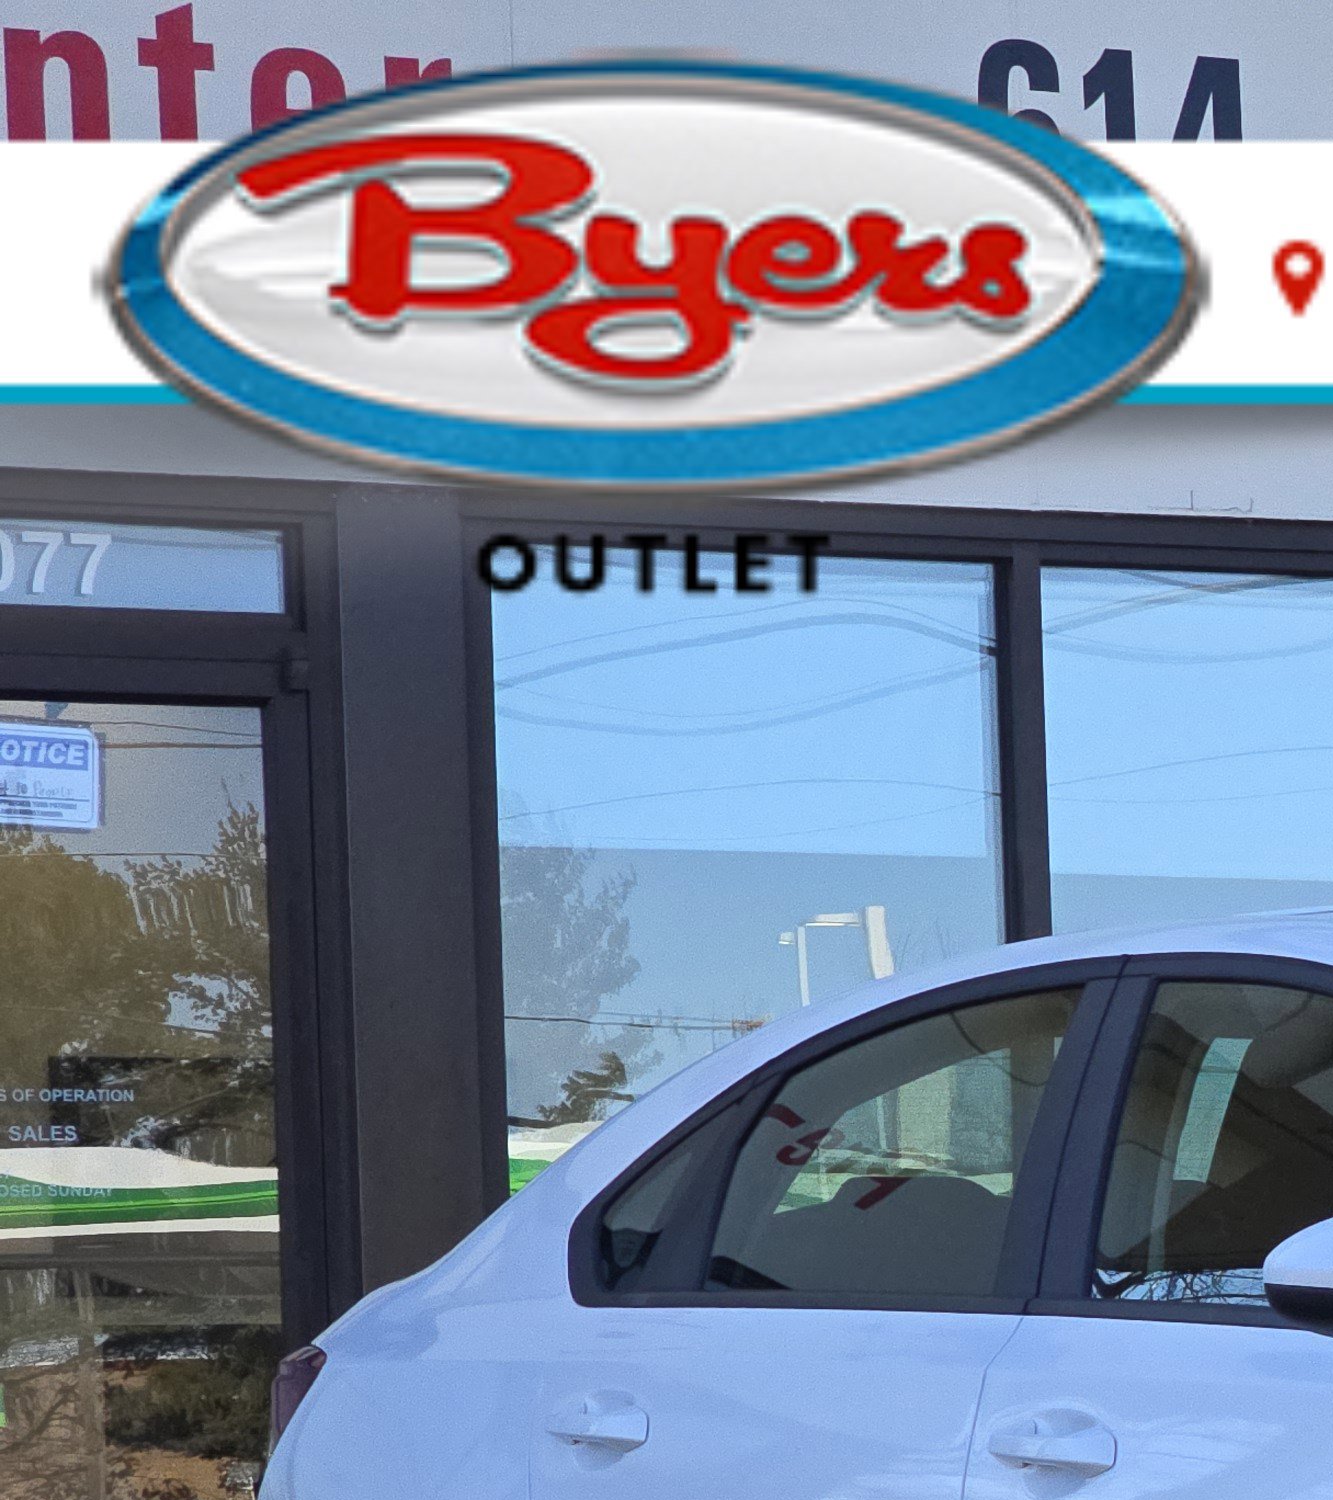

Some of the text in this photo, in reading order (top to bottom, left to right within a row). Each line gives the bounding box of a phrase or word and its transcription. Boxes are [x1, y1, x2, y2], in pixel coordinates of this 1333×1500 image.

[12, 1088, 35, 1102] OF
[39, 1088, 134, 1103] OPERATION
[8, 1125, 78, 1142] SALES
